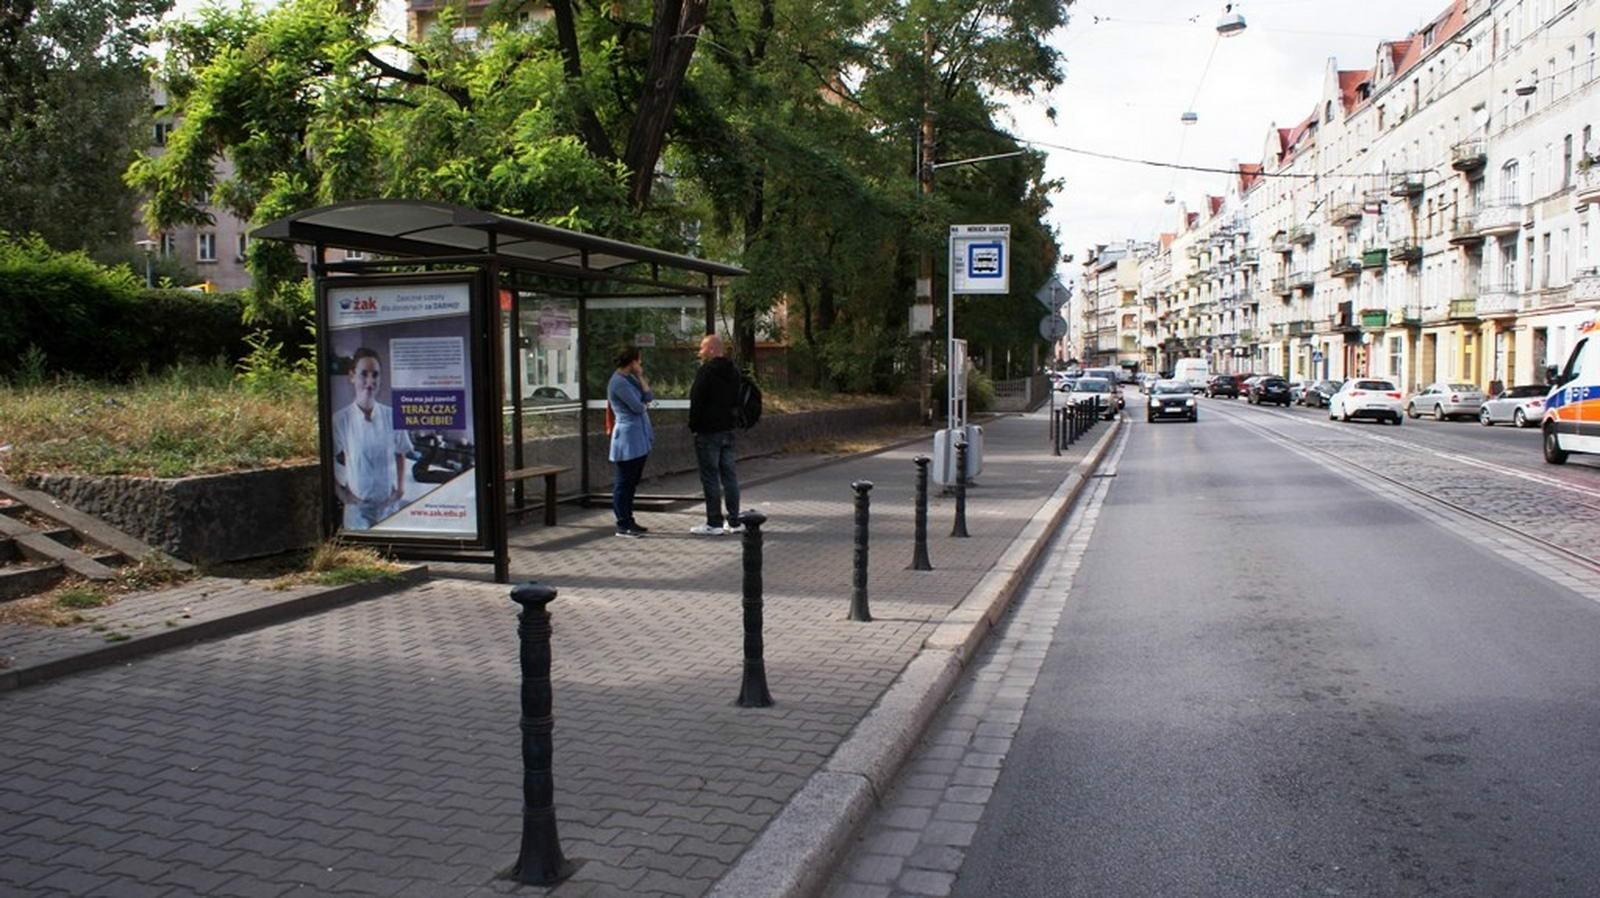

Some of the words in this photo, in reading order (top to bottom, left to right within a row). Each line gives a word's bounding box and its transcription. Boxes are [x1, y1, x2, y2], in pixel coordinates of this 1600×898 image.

[353, 296, 377, 311] żak
[401, 404, 431, 414] TERAZ
[431, 404, 457, 414] CZAS
[405, 416, 420, 425] NA
[420, 416, 453, 425] CIEBIE!
